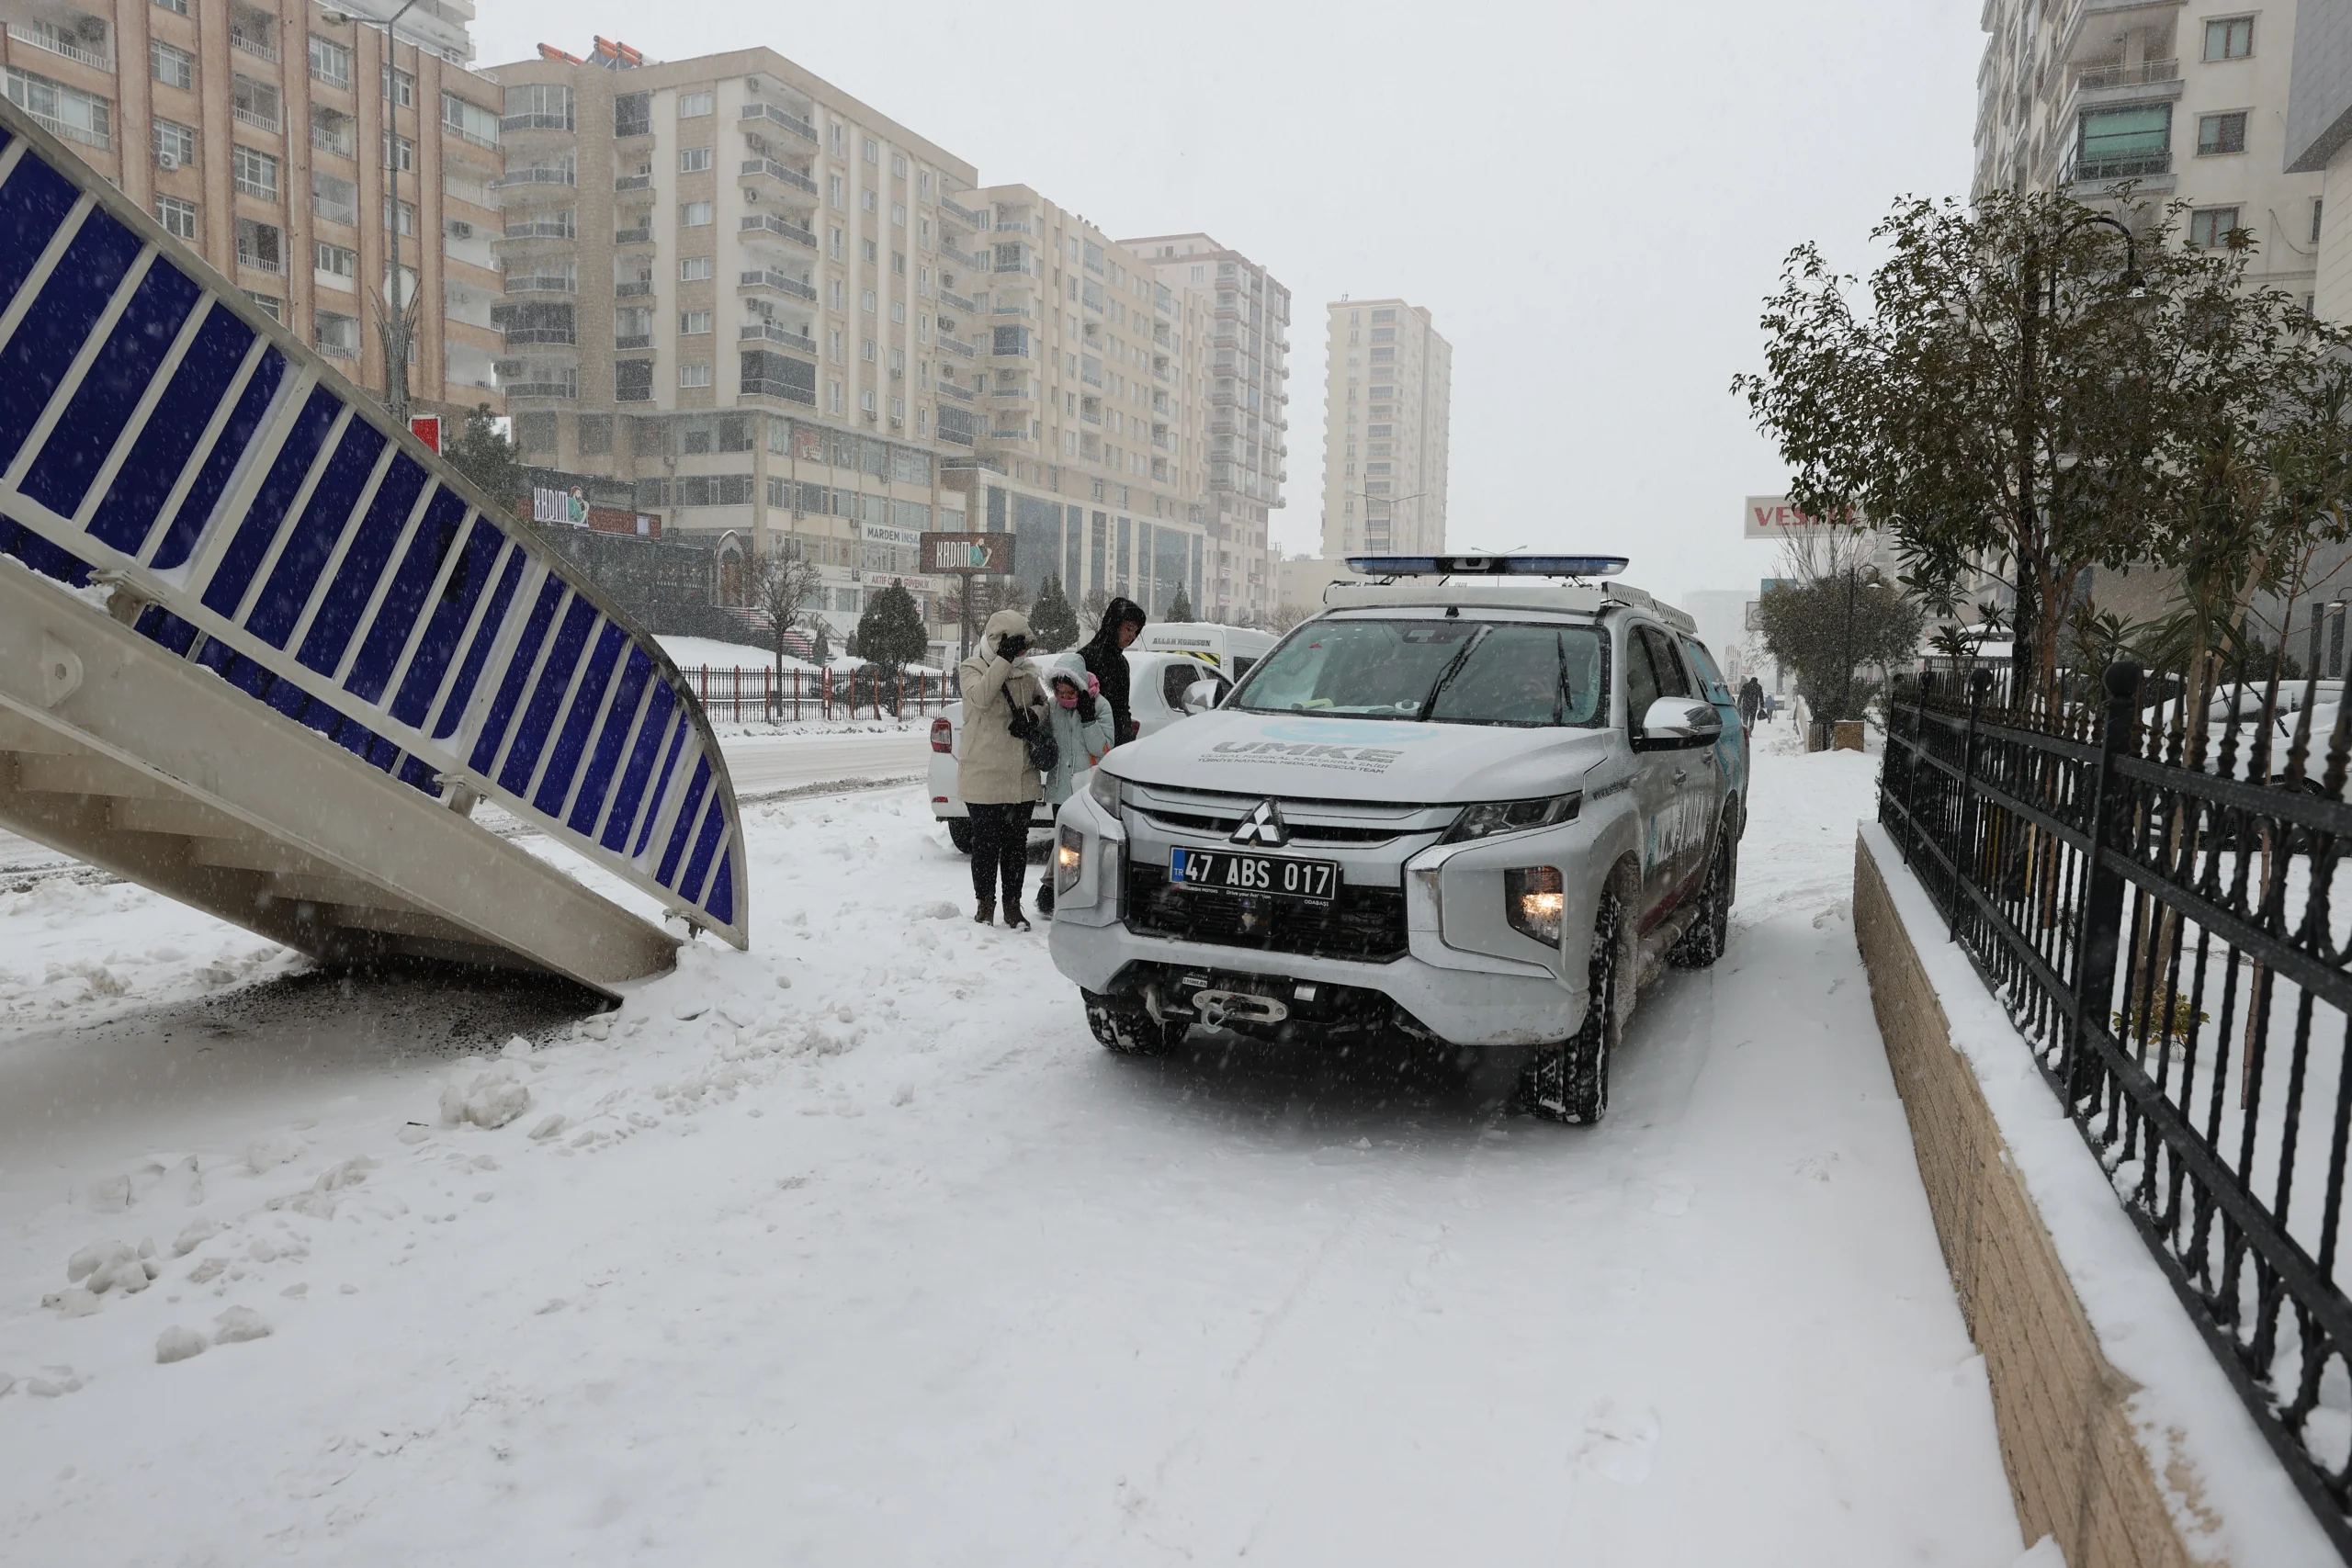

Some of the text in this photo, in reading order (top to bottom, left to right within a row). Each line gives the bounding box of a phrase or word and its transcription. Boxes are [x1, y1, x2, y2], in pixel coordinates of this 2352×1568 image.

[867, 526, 899, 542] MARDEM
[936, 542, 970, 568] KADİM
[903, 576, 930, 590] GÜVENLİK
[1152, 637, 1211, 647] ALLAH KORUSUN
[1212, 741, 1405, 764] UMKE
[1320, 763, 1357, 772] RESCUE
[1173, 867, 1184, 877] TR
[1185, 853, 1330, 895] 47 ABS 017
